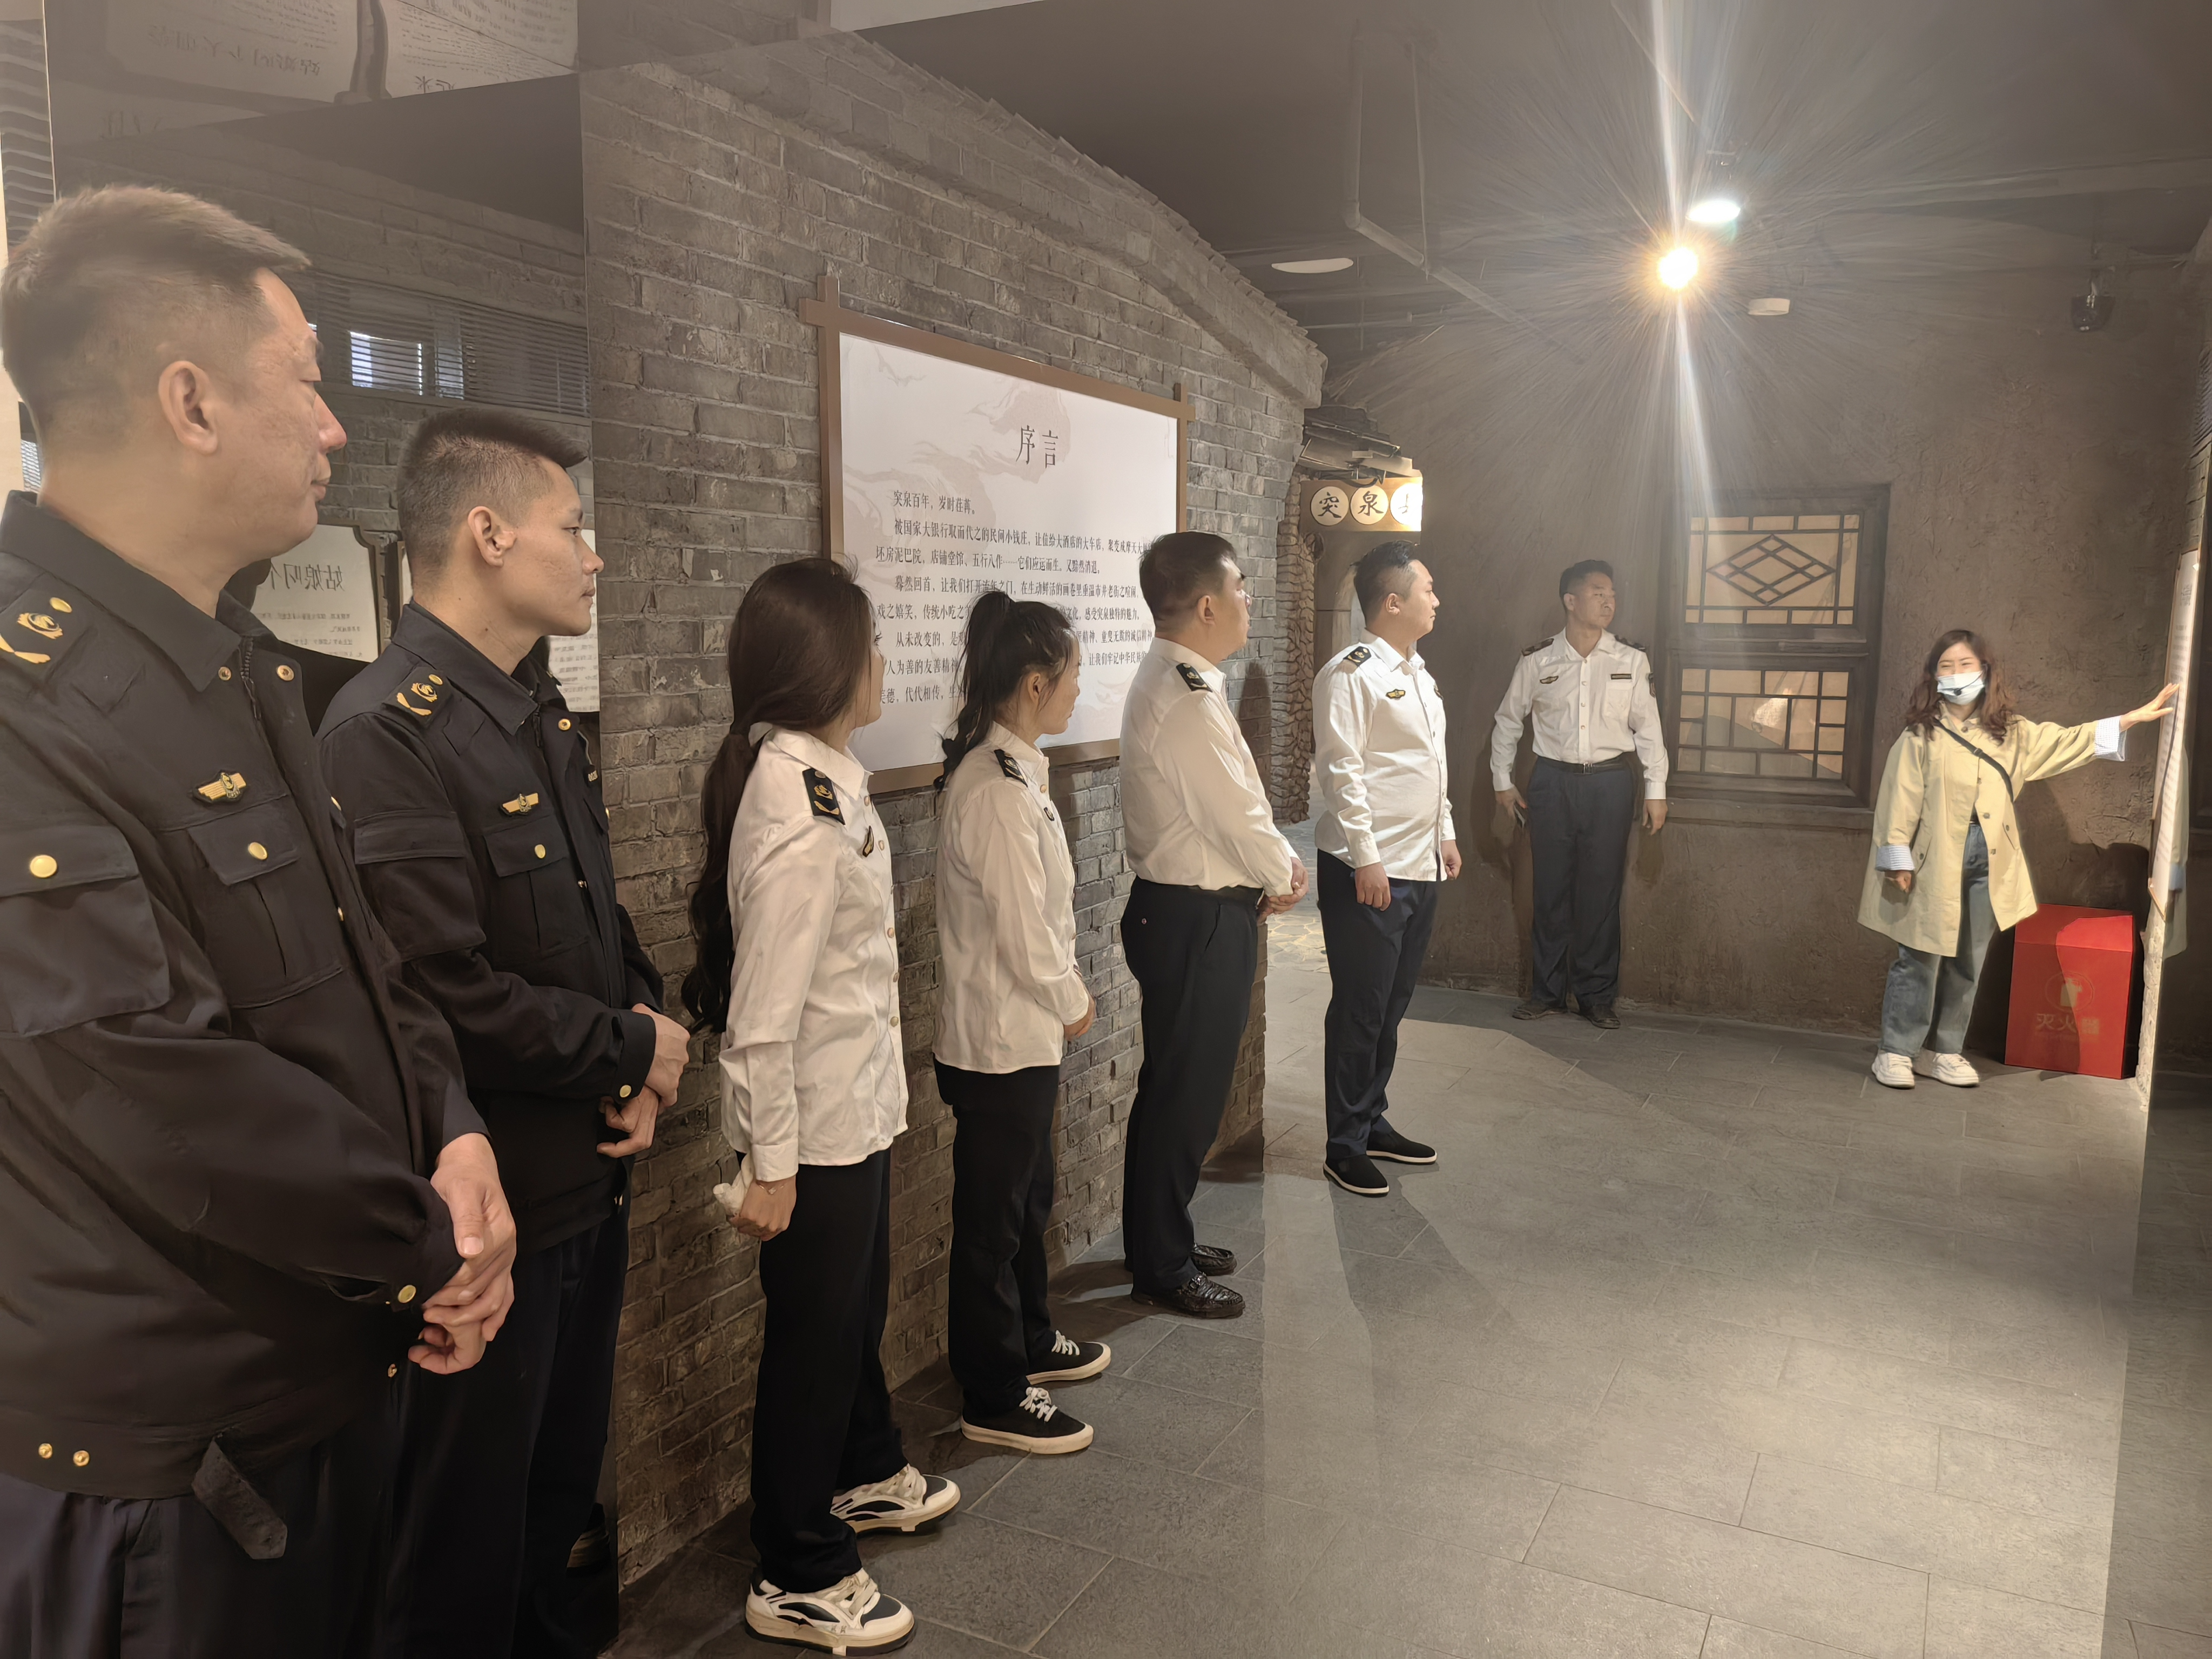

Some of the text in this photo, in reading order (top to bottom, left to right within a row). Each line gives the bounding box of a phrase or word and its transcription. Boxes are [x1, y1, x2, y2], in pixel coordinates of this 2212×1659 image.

[1015, 424, 1058, 469] 序言
[893, 490, 975, 515] 突泉百年，岁时荏苒。
